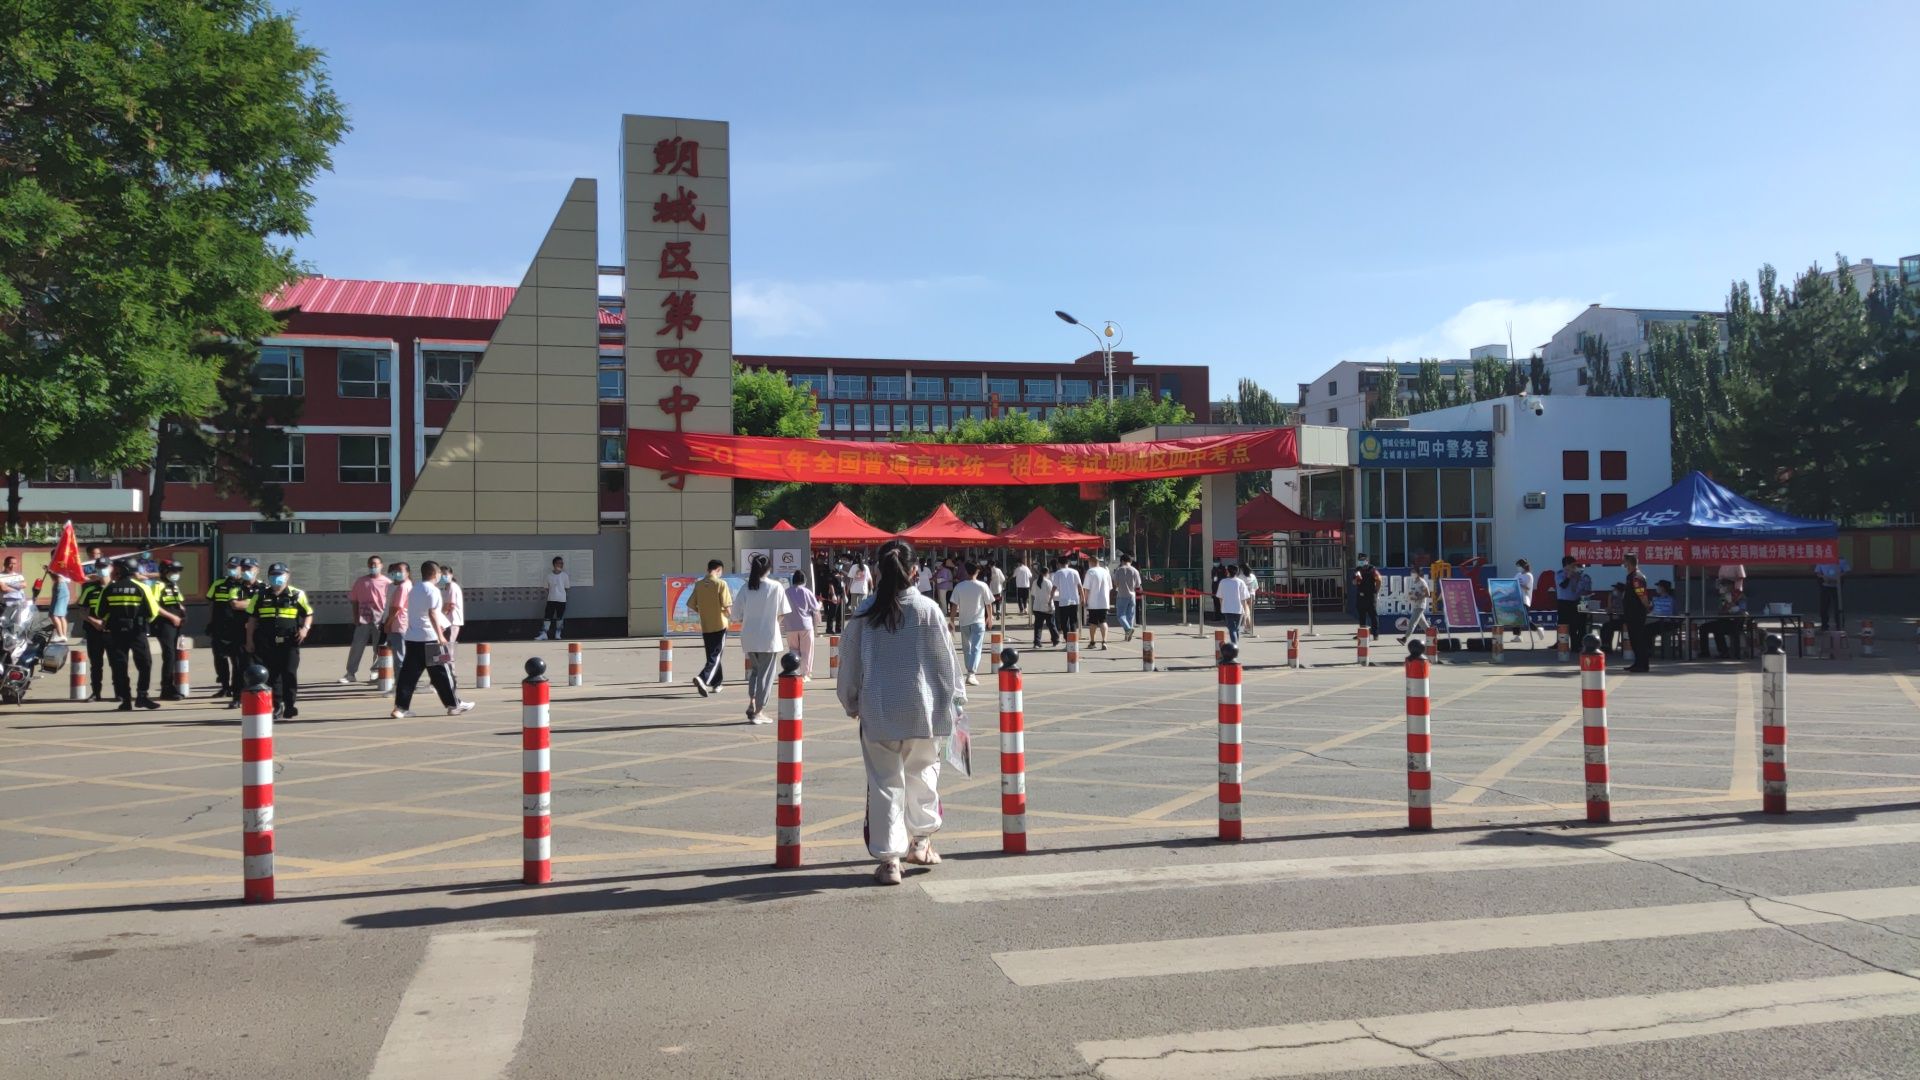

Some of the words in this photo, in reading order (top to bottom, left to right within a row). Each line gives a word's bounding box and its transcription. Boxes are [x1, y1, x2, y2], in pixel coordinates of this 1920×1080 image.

[1417, 438, 1489, 459] 四中警务室
[1616, 508, 1681, 527] 公安
[1700, 506, 1775, 527] 公安
[1645, 545, 1684, 561] 保驾护航
[1691, 543, 1834, 560] 朔州市公安局朔城分局考生服务点
